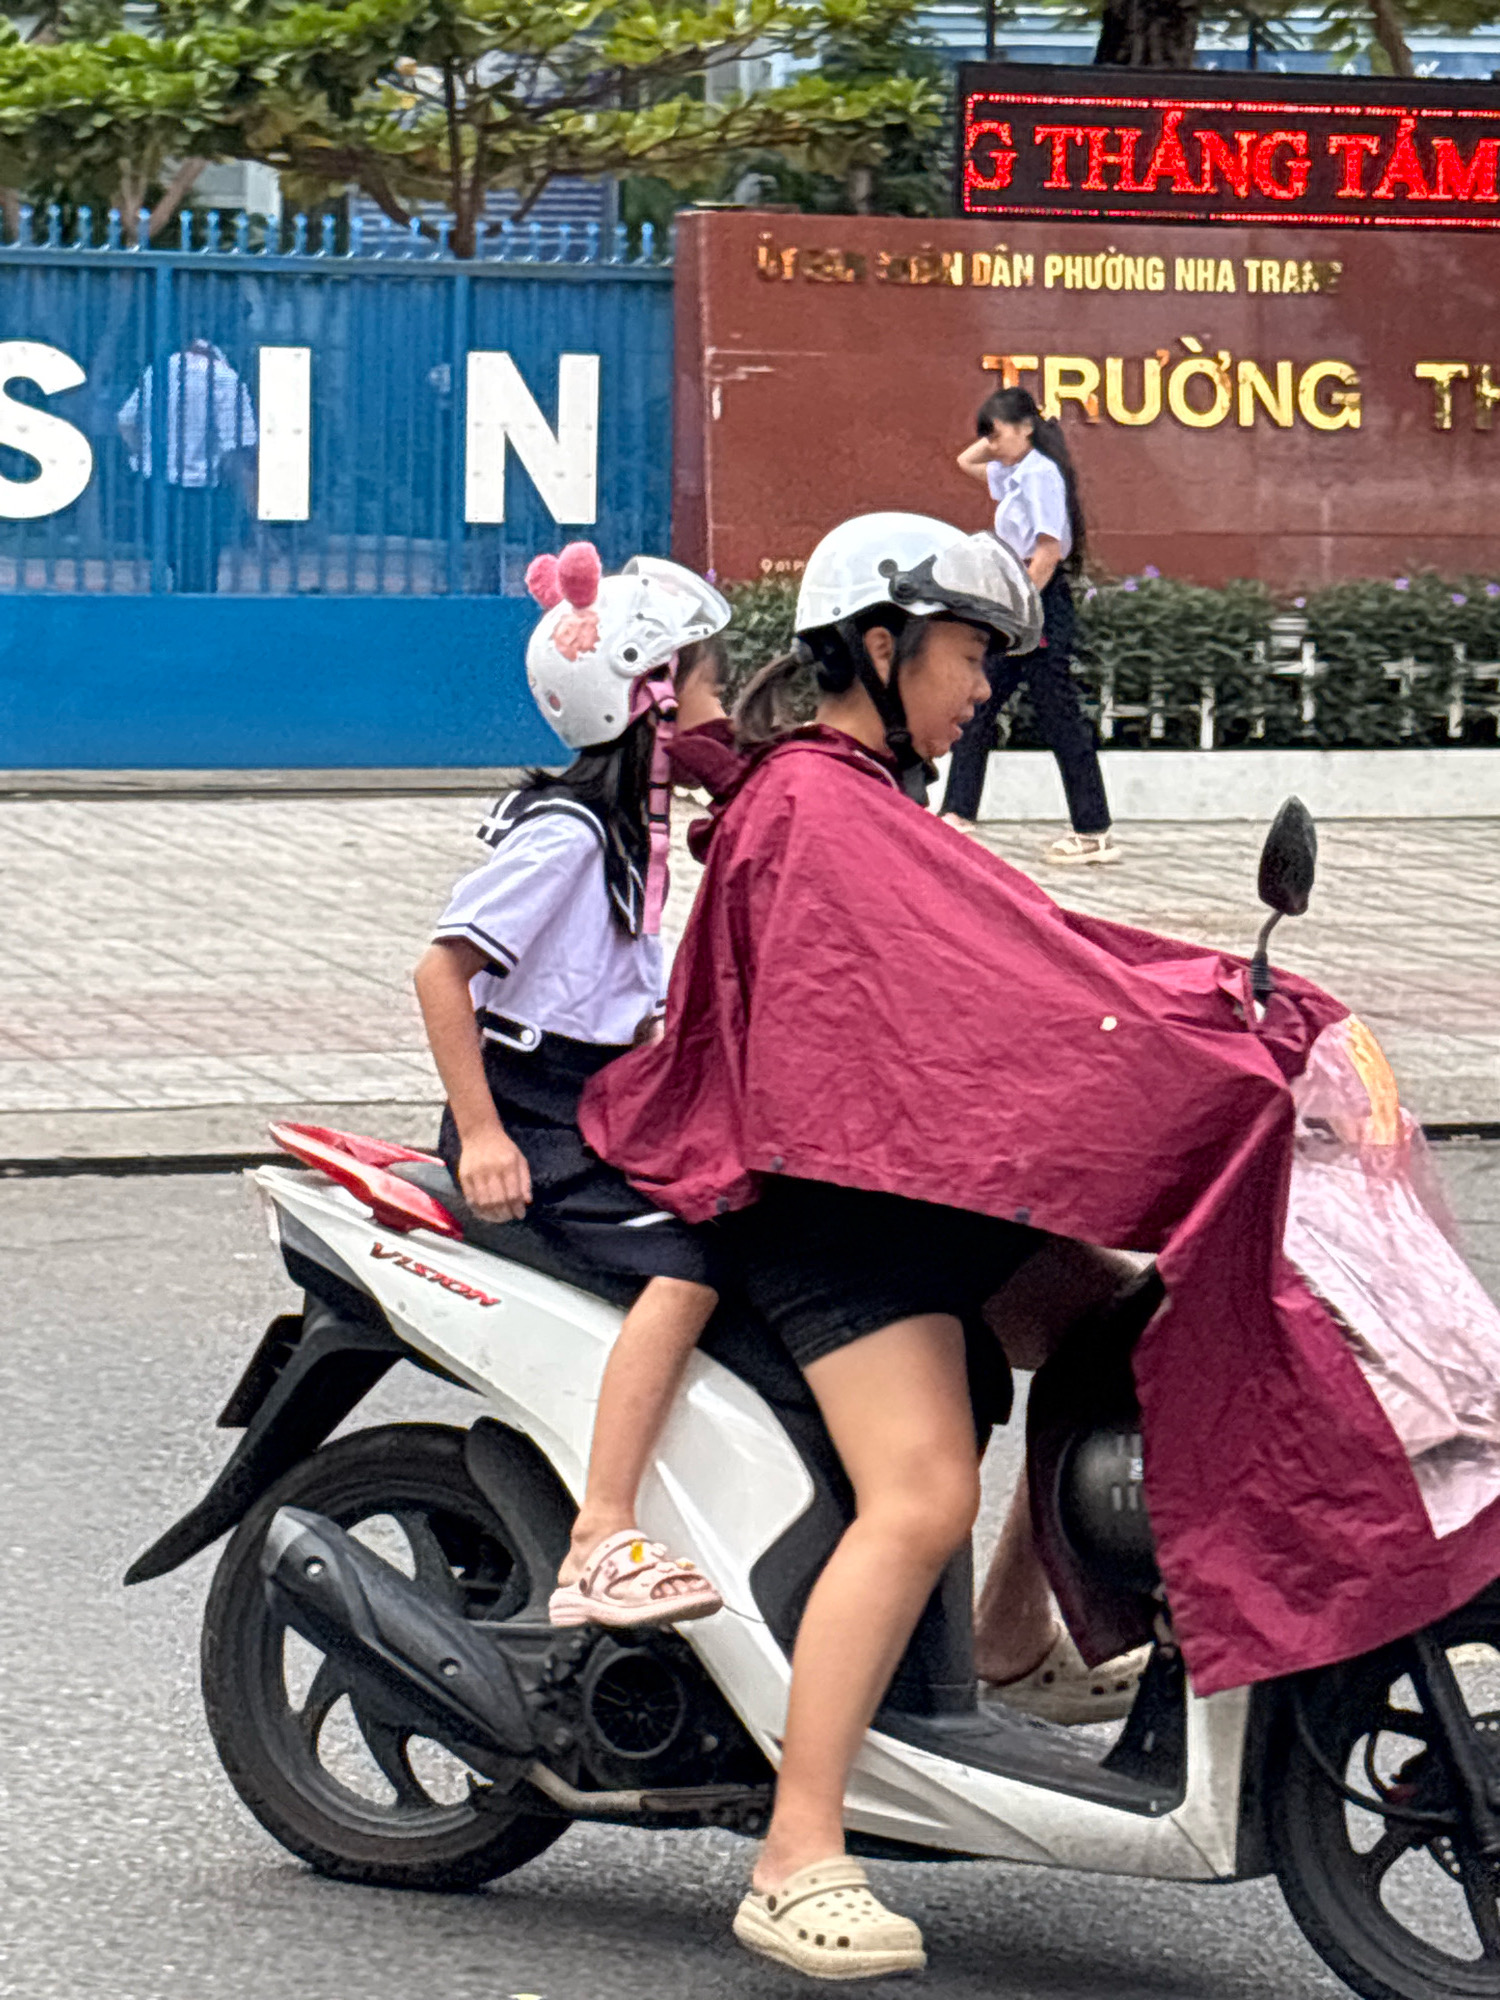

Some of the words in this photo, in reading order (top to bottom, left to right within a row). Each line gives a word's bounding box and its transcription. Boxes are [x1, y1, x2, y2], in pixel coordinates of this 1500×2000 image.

[972, 243, 1035, 288] DÂN
[1044, 245, 1166, 291] PHƯỜNG
[1174, 257, 1237, 293] NHA
[982, 335, 1362, 431] TRƯỜNG
[369, 1241, 502, 1307] VISION
